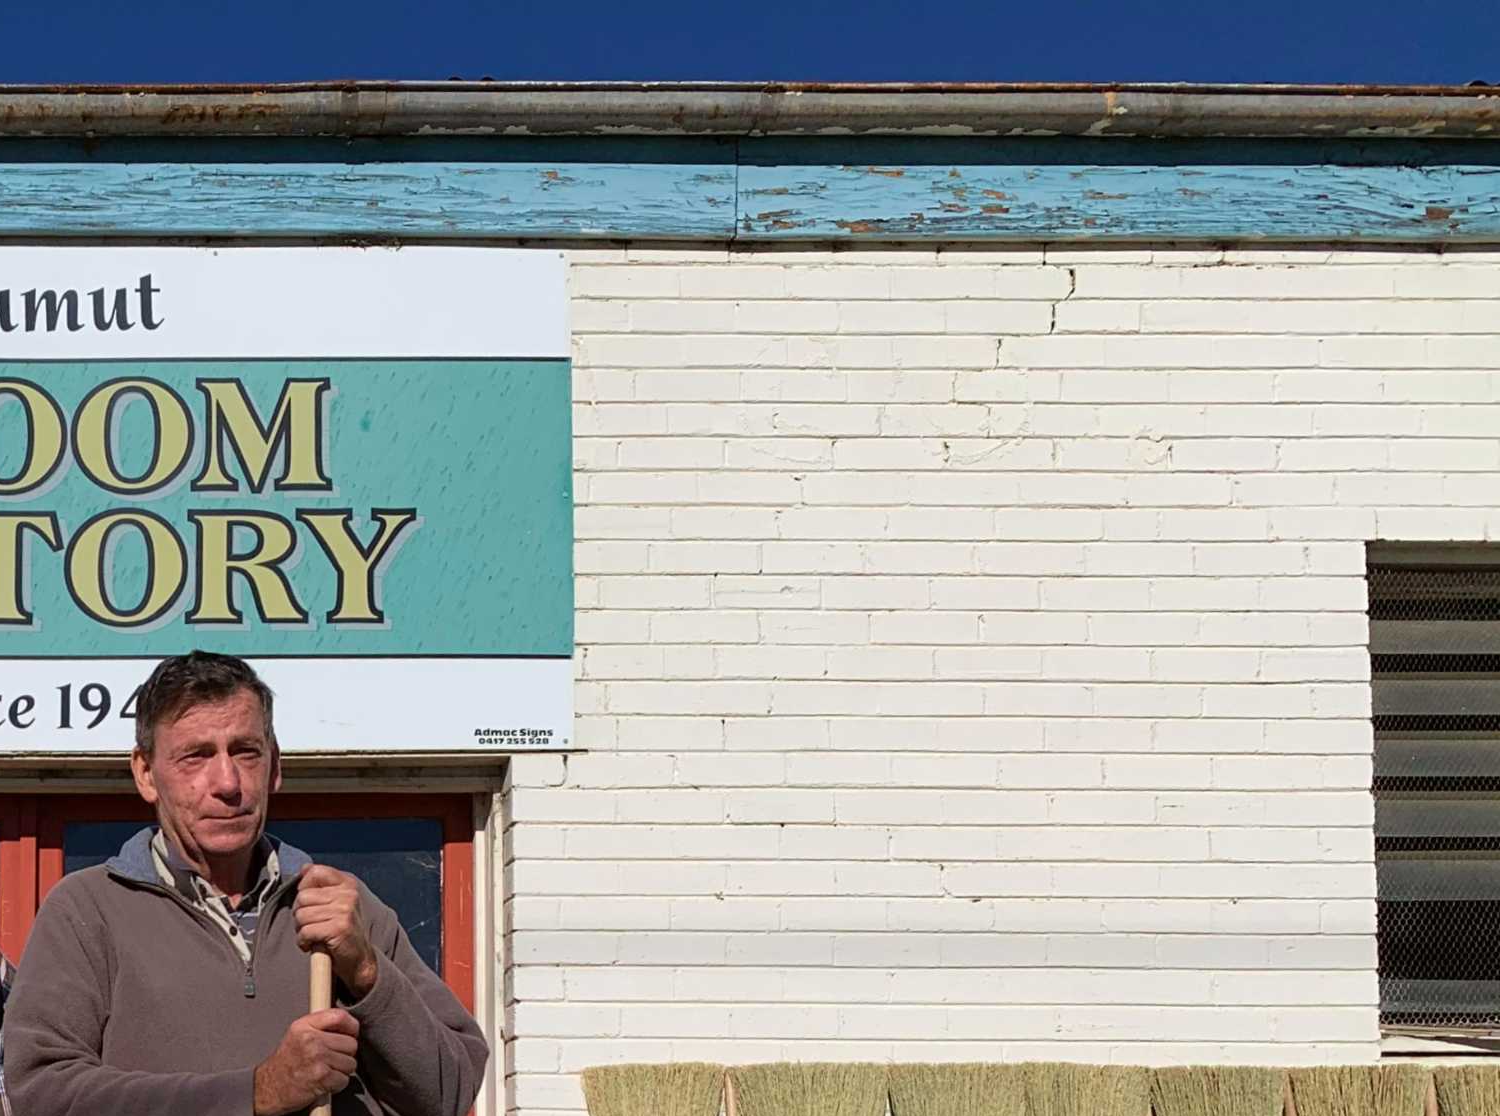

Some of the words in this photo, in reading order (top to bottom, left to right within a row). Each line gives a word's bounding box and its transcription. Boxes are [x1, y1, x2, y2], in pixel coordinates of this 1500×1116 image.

[55, 682, 145, 730] 194
[474, 728, 518, 737] Admac
[519, 728, 554, 738] Signs
[478, 737, 505, 745] 0417
